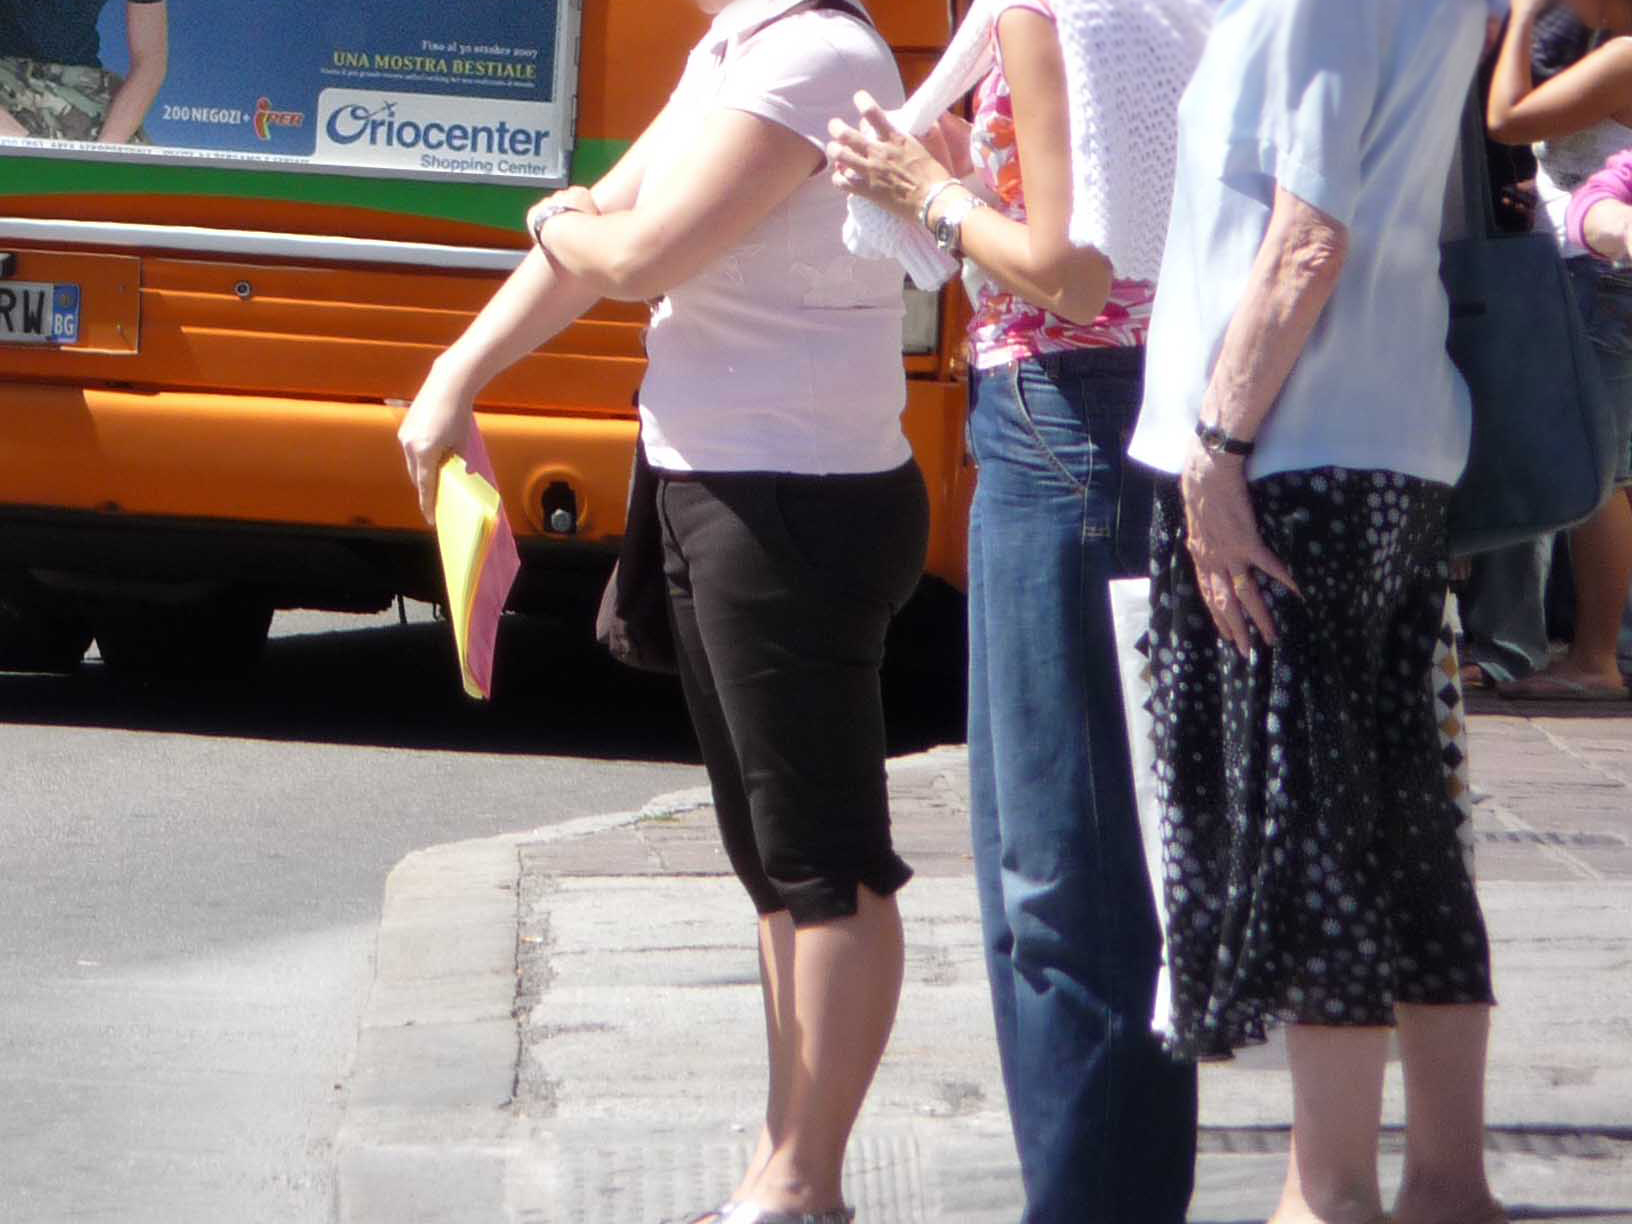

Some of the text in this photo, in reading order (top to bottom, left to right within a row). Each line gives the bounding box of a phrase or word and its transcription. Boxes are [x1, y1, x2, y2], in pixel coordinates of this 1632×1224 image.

[447, 41, 458, 53] al
[333, 51, 369, 67] UNA
[375, 55, 447, 74] MOSTRA
[452, 60, 537, 79] BESTIALE
[162, 106, 190, 120] 200
[326, 101, 550, 157] Oriocenter
[421, 154, 547, 176] Shopping Center
[54, 312, 75, 336] BG
